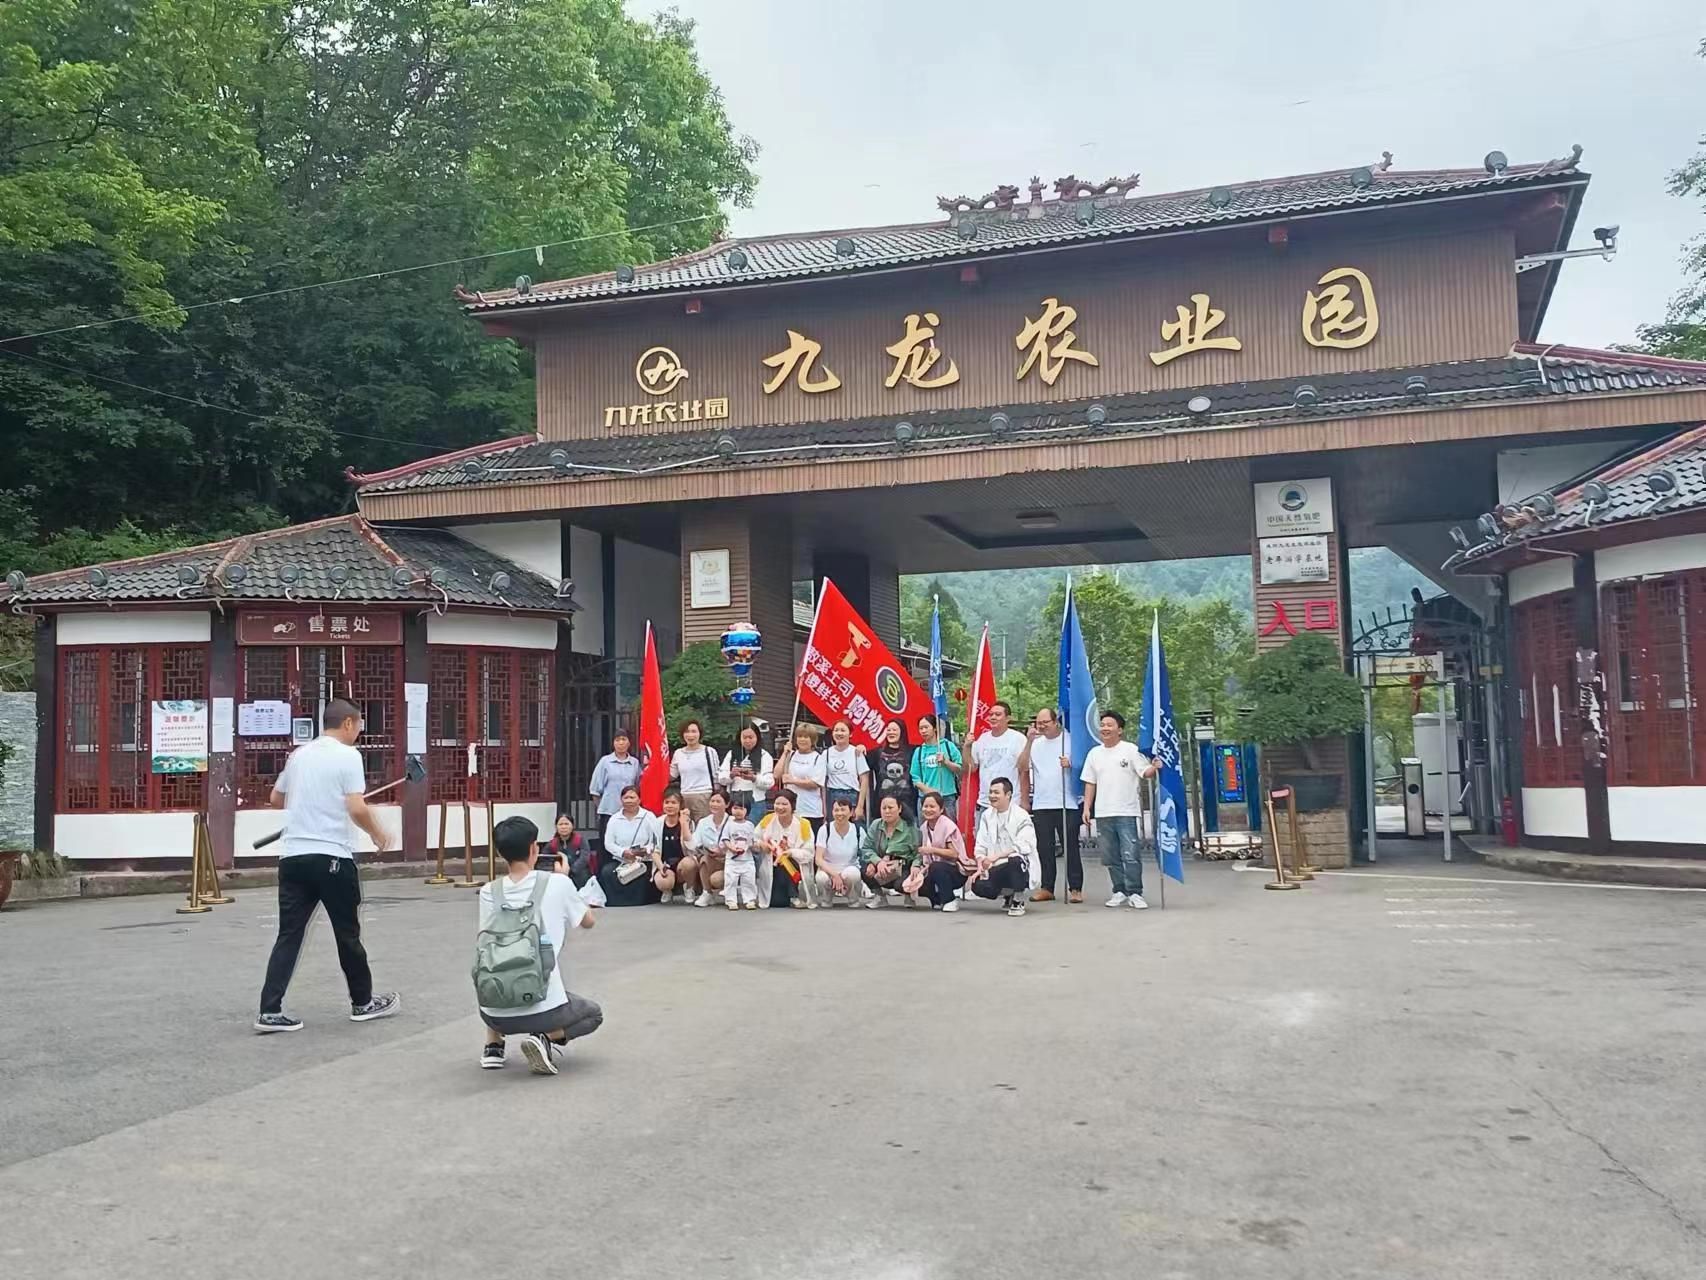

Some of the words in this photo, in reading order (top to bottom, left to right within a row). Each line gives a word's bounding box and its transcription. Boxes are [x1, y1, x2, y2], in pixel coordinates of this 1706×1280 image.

[762, 267, 1380, 394] 九龙农业园
[605, 397, 729, 428] 九龙农业园
[308, 616, 371, 633] 售票处
[1263, 600, 1337, 636] 入口
